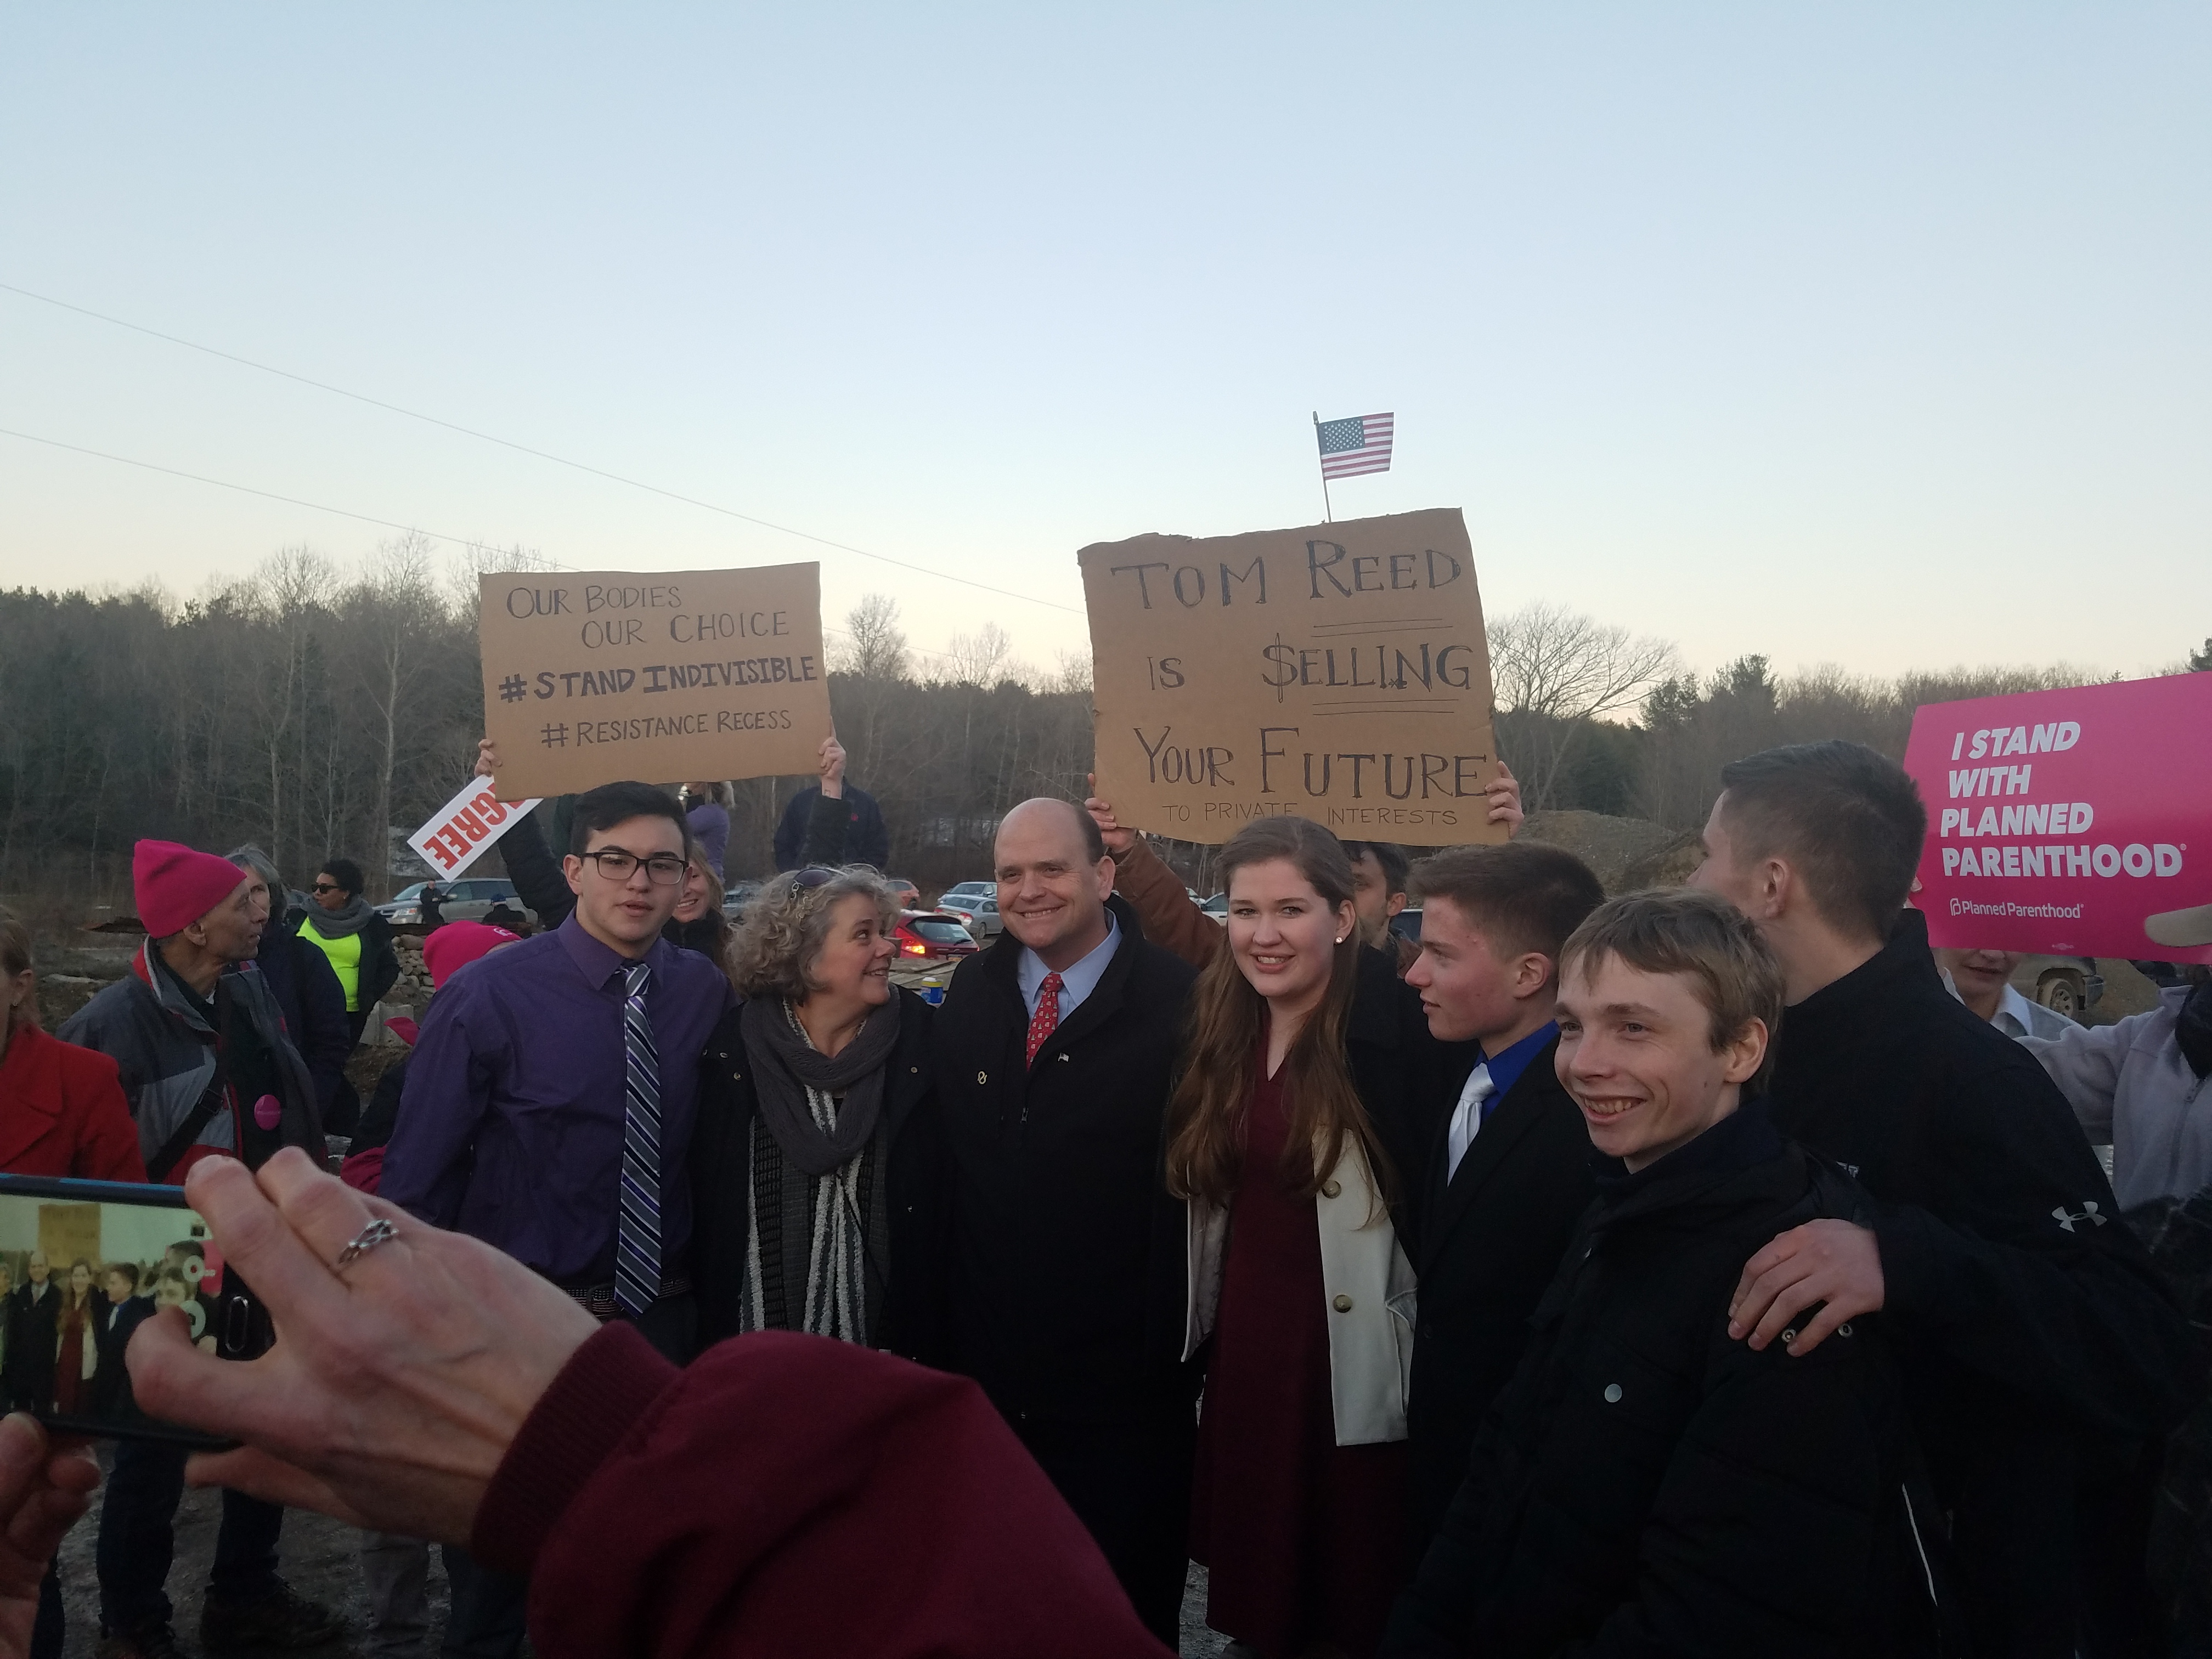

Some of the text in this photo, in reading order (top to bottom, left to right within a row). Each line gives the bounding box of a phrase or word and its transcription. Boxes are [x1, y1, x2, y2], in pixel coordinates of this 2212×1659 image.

[1111, 540, 1462, 610] TOM REED
[506, 585, 682, 619] OUR BODIES
[582, 611, 789, 648] OUR CHOICE
[1148, 656, 1186, 691] IS
[1951, 721, 2081, 761] I STAND
[1133, 726, 1489, 799] YOUR FUTURE
[1949, 764, 2032, 799] WITH
[1162, 805, 1190, 822] TO
[1327, 806, 1458, 826] INTERESTS
[1940, 802, 2094, 838] PLANNED
[1961, 900, 2006, 916] Planned
